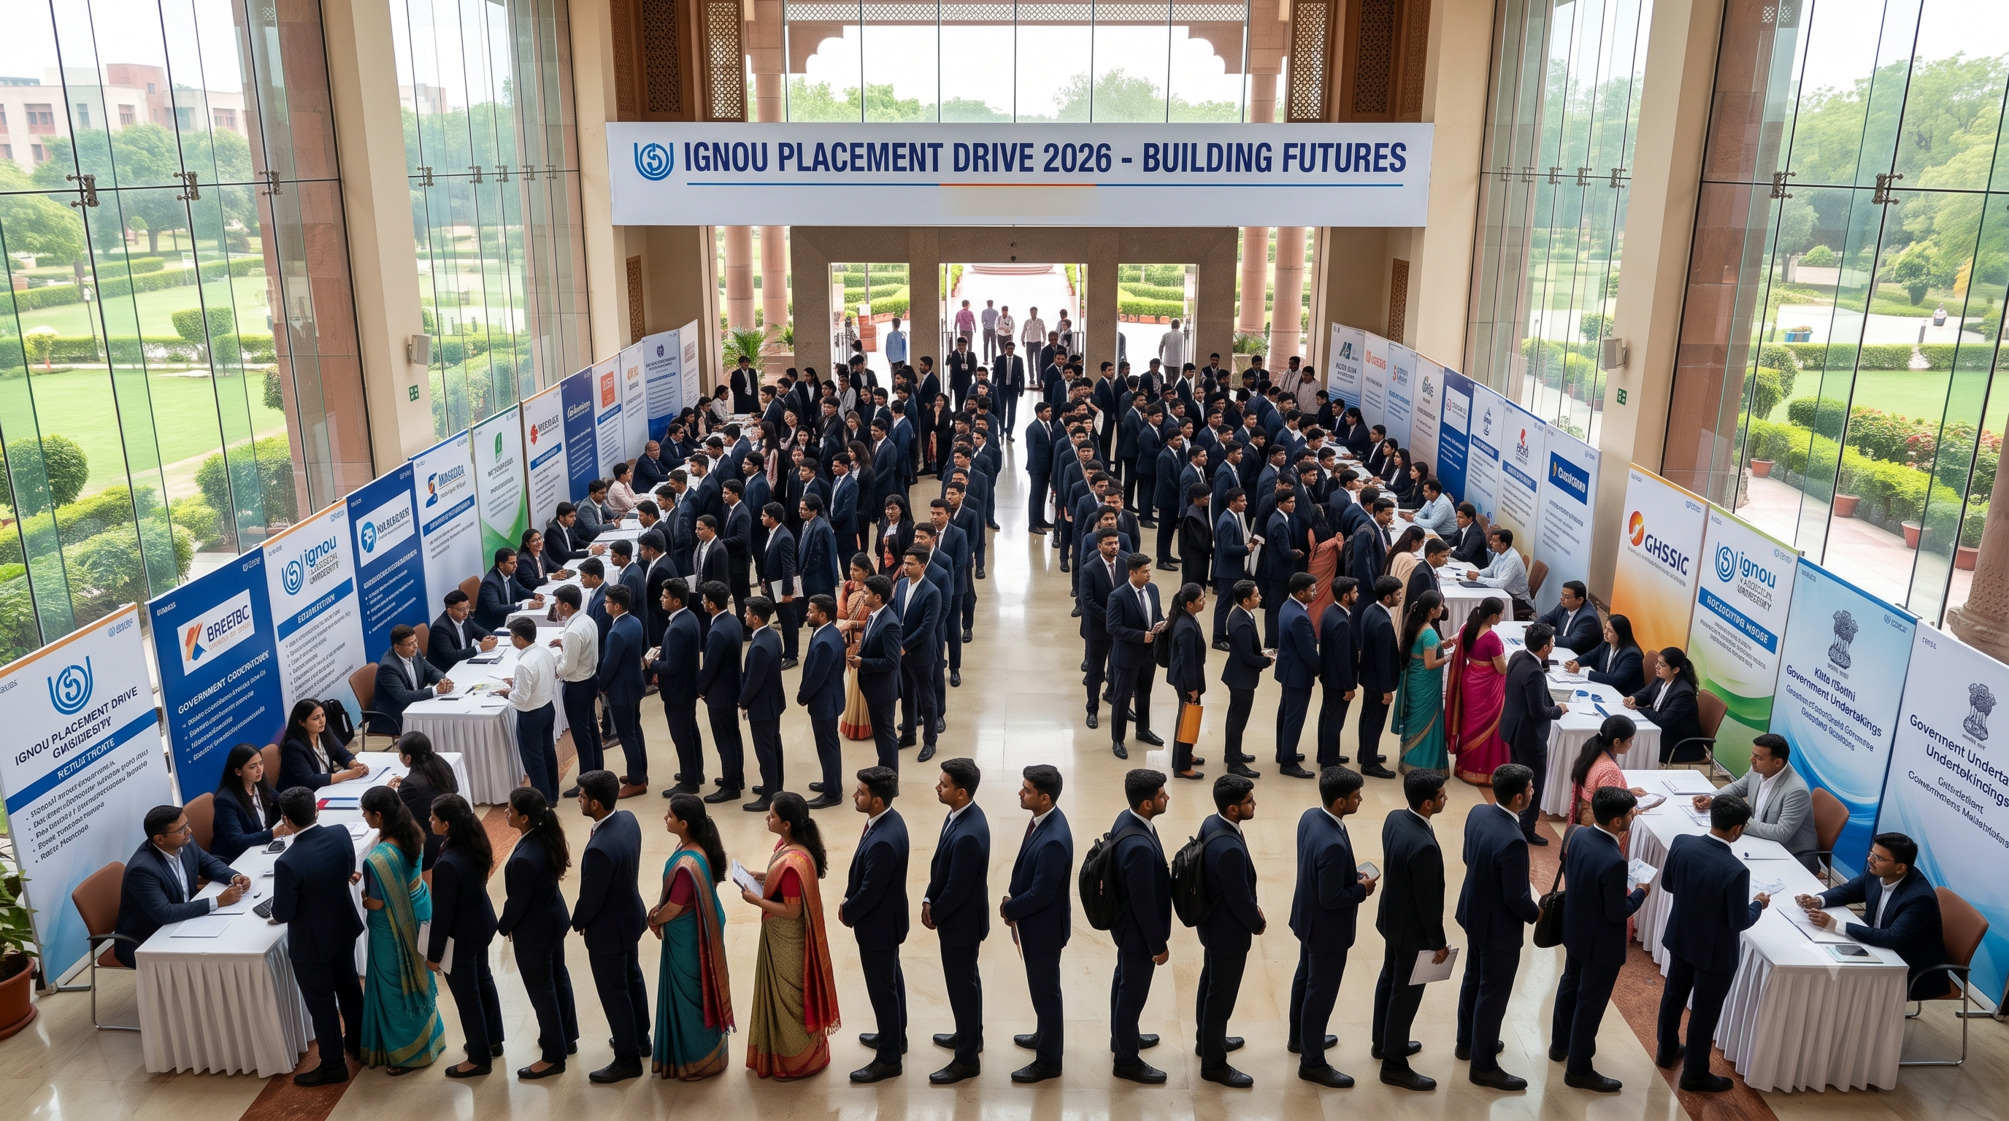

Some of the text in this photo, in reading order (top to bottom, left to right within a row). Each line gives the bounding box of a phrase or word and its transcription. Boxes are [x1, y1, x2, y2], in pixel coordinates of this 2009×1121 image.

[684, 141, 769, 173] IGNOU
[778, 141, 944, 173] PLACEMENT
[953, 142, 1035, 173] DRIVE
[1043, 142, 1113, 173] 2026
[1143, 141, 1273, 173] BUILDING
[1282, 141, 1407, 173] FUTURES
[304, 535, 337, 568] ignou
[1739, 551, 1777, 590] ignou
[206, 604, 250, 643] BREETBC
[178, 677, 226, 715] GOVERNMENT
[1786, 664, 1830, 701] Government
[15, 686, 139, 767] IGNOU PLACEMENT DRIVE
